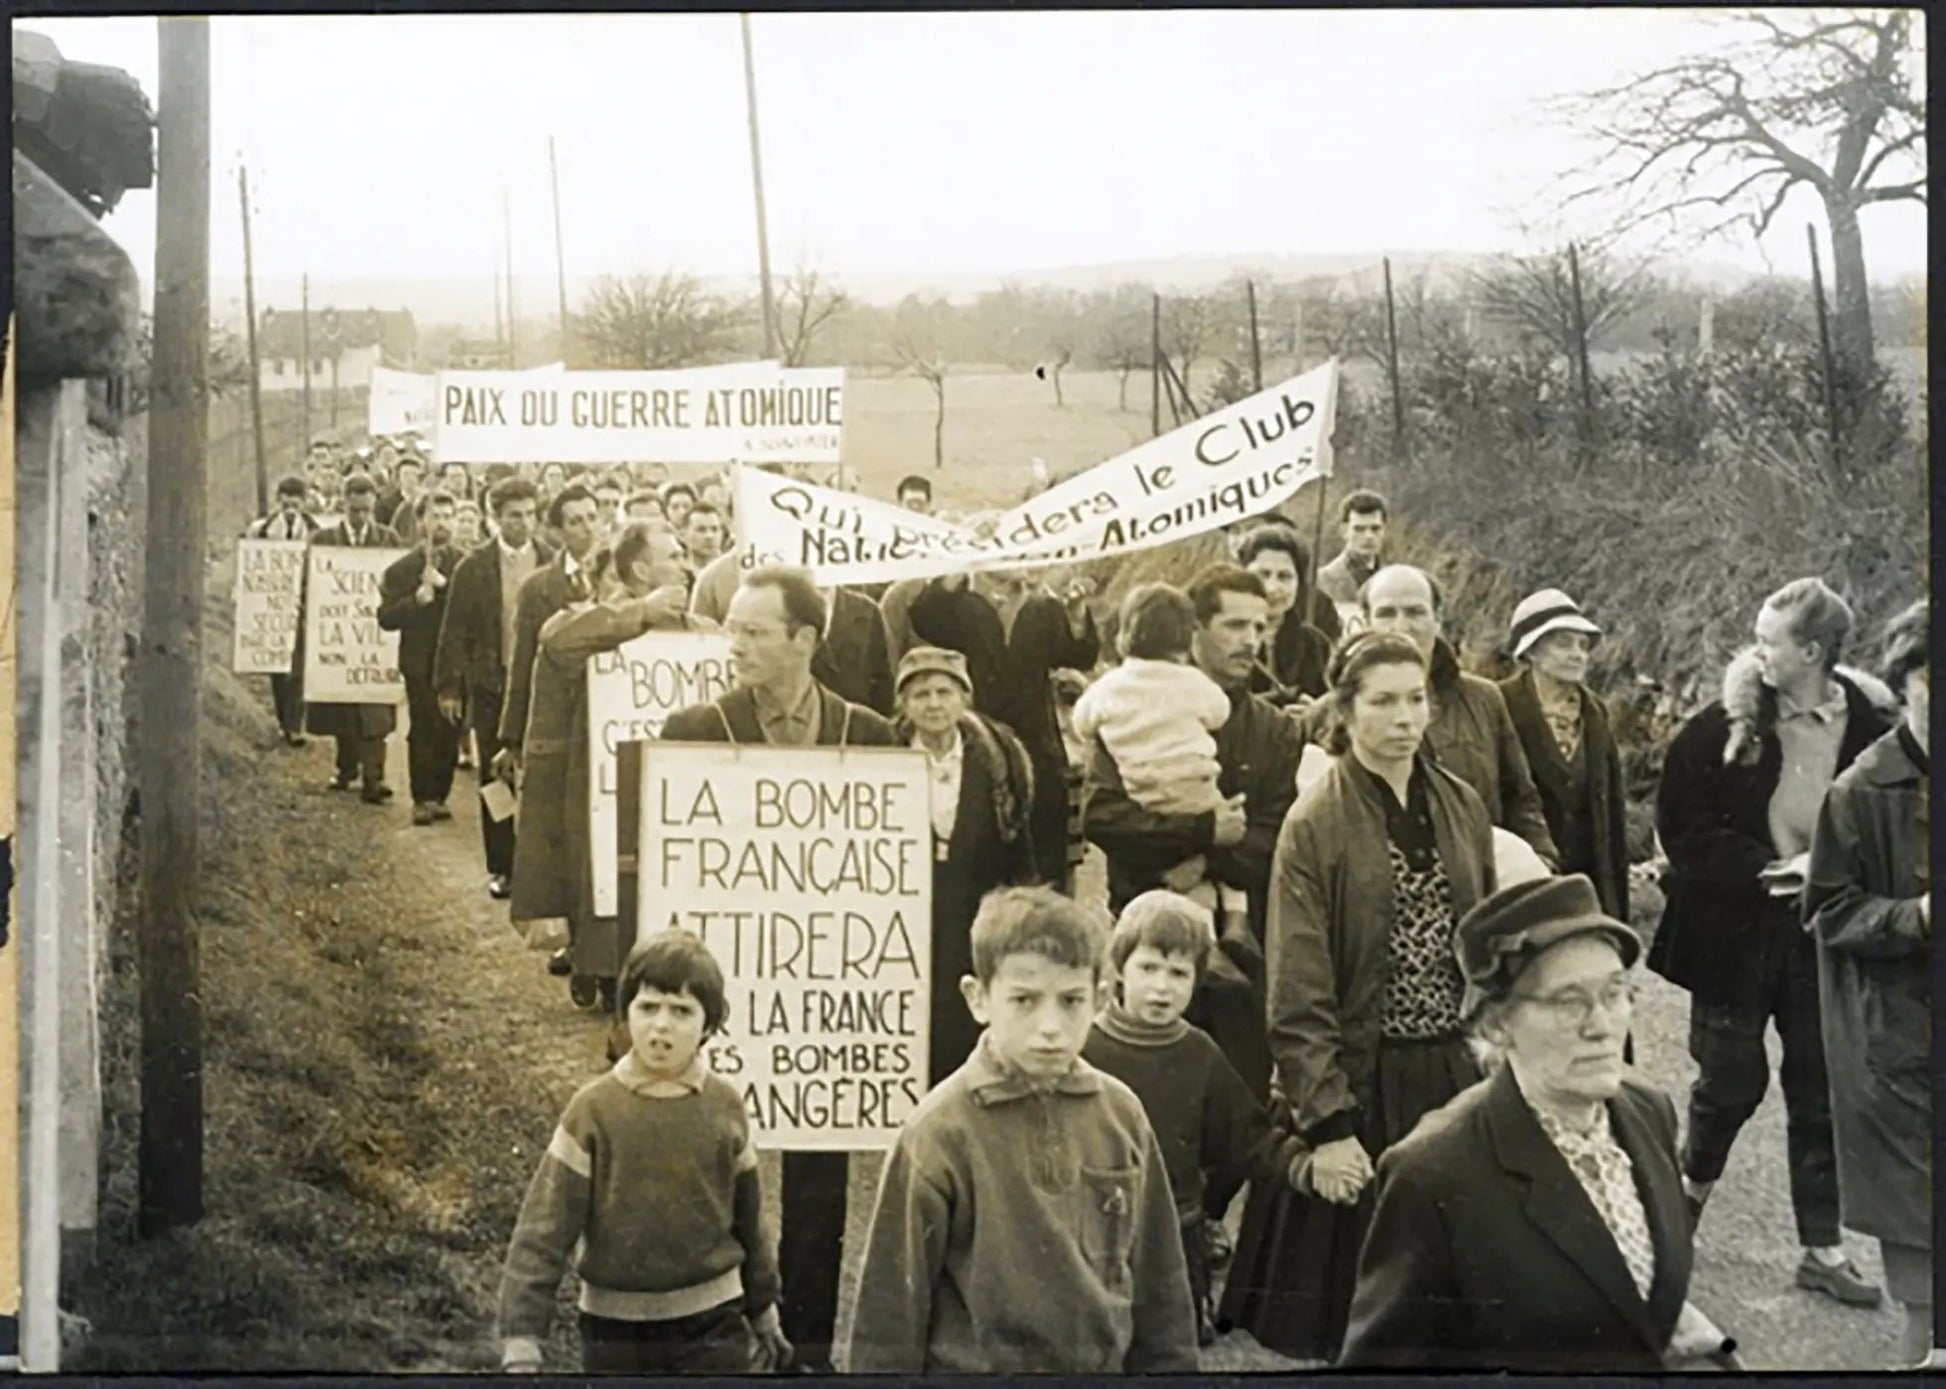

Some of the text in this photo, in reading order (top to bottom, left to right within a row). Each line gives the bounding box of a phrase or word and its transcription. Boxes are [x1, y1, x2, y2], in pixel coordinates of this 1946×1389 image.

[445, 384, 507, 426] PAIX
[521, 389, 558, 427] OU
[571, 388, 690, 428] GUERRE
[770, 487, 862, 534] Qui
[1132, 463, 1176, 496] le
[1194, 394, 1316, 467] Club
[319, 622, 344, 646] LA
[661, 778, 907, 832] LA BOMBE
[662, 837, 920, 896] FRANÇAISE
[667, 910, 921, 981] TTIRERA
[749, 989, 917, 1038] LA FRANCE
[708, 1042, 911, 1077] ES BOMBES
